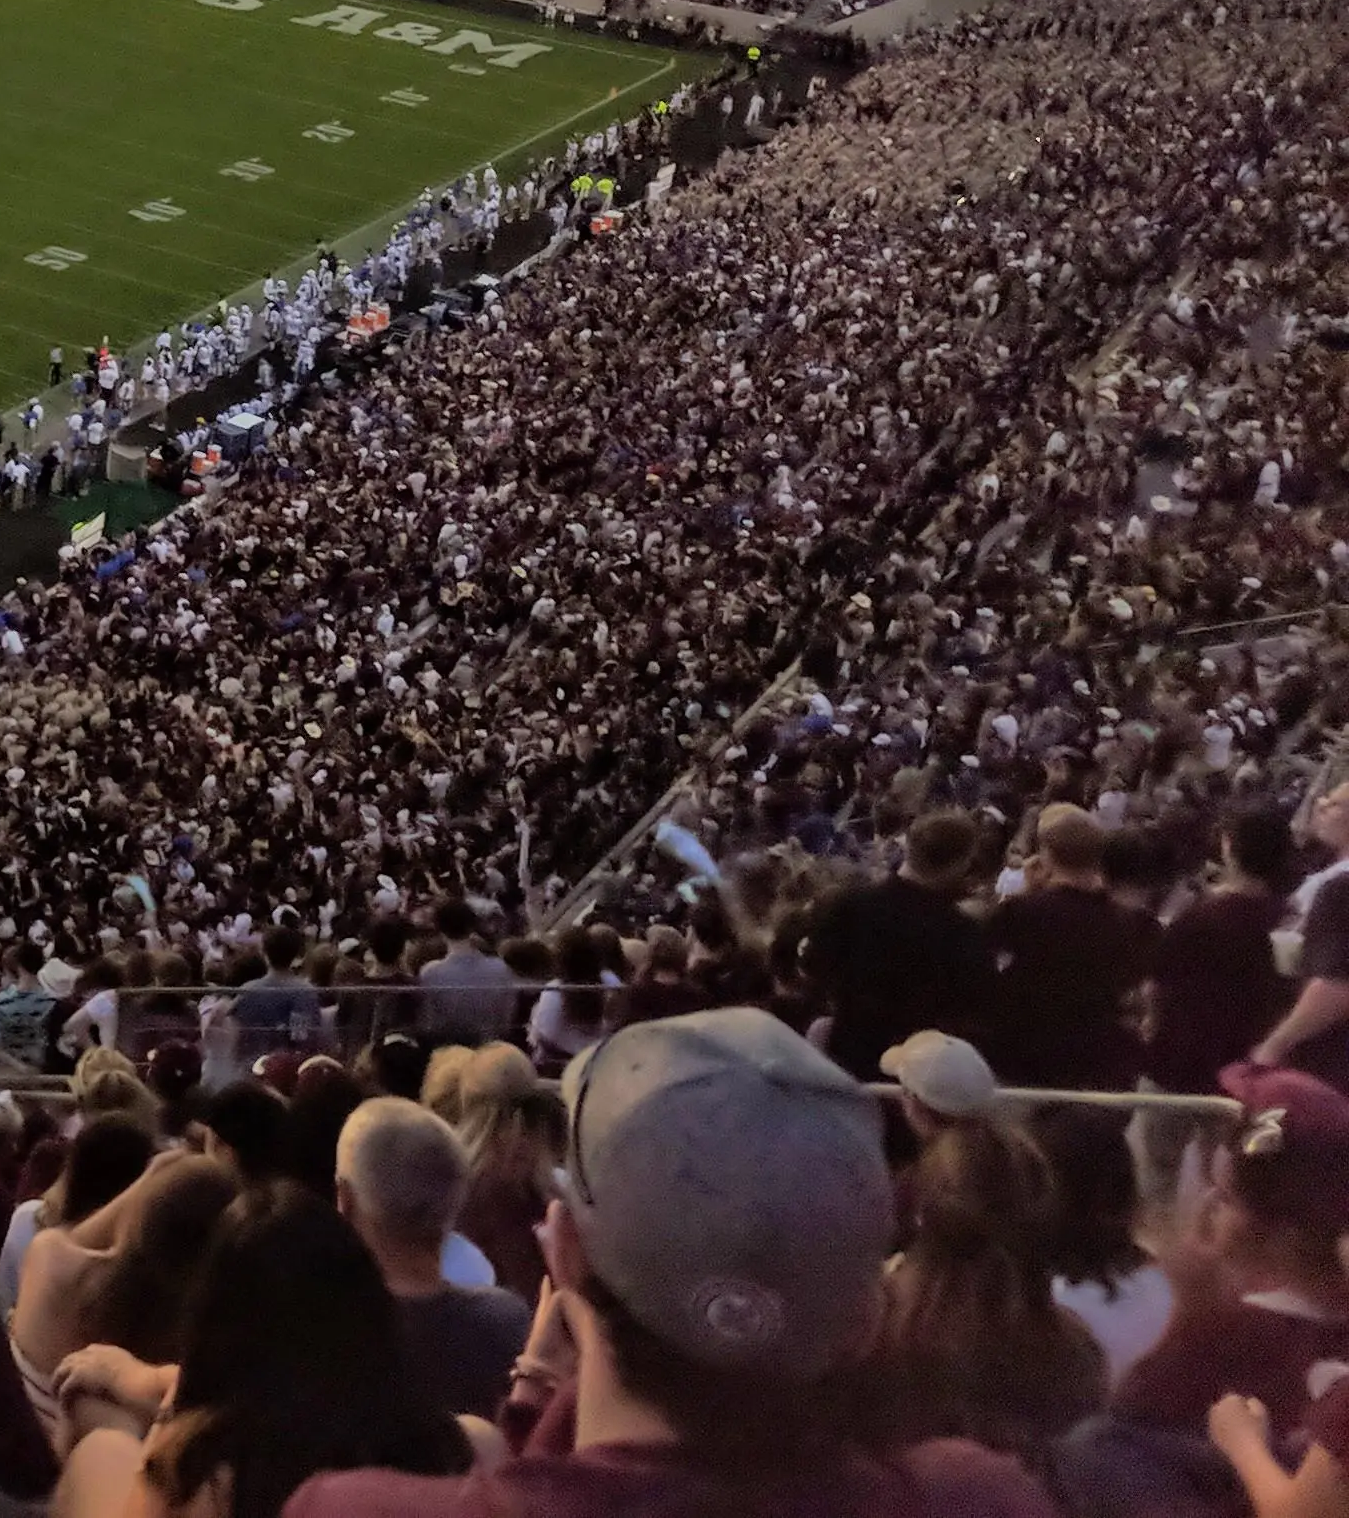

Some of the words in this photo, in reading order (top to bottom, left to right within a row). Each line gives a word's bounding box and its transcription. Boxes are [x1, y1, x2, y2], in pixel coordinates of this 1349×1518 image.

[290, 3, 553, 69] A&M
[302, 124, 355, 142] 20
[218, 160, 275, 182] 30
[128, 201, 187, 222] 40
[23, 245, 89, 271] 50
